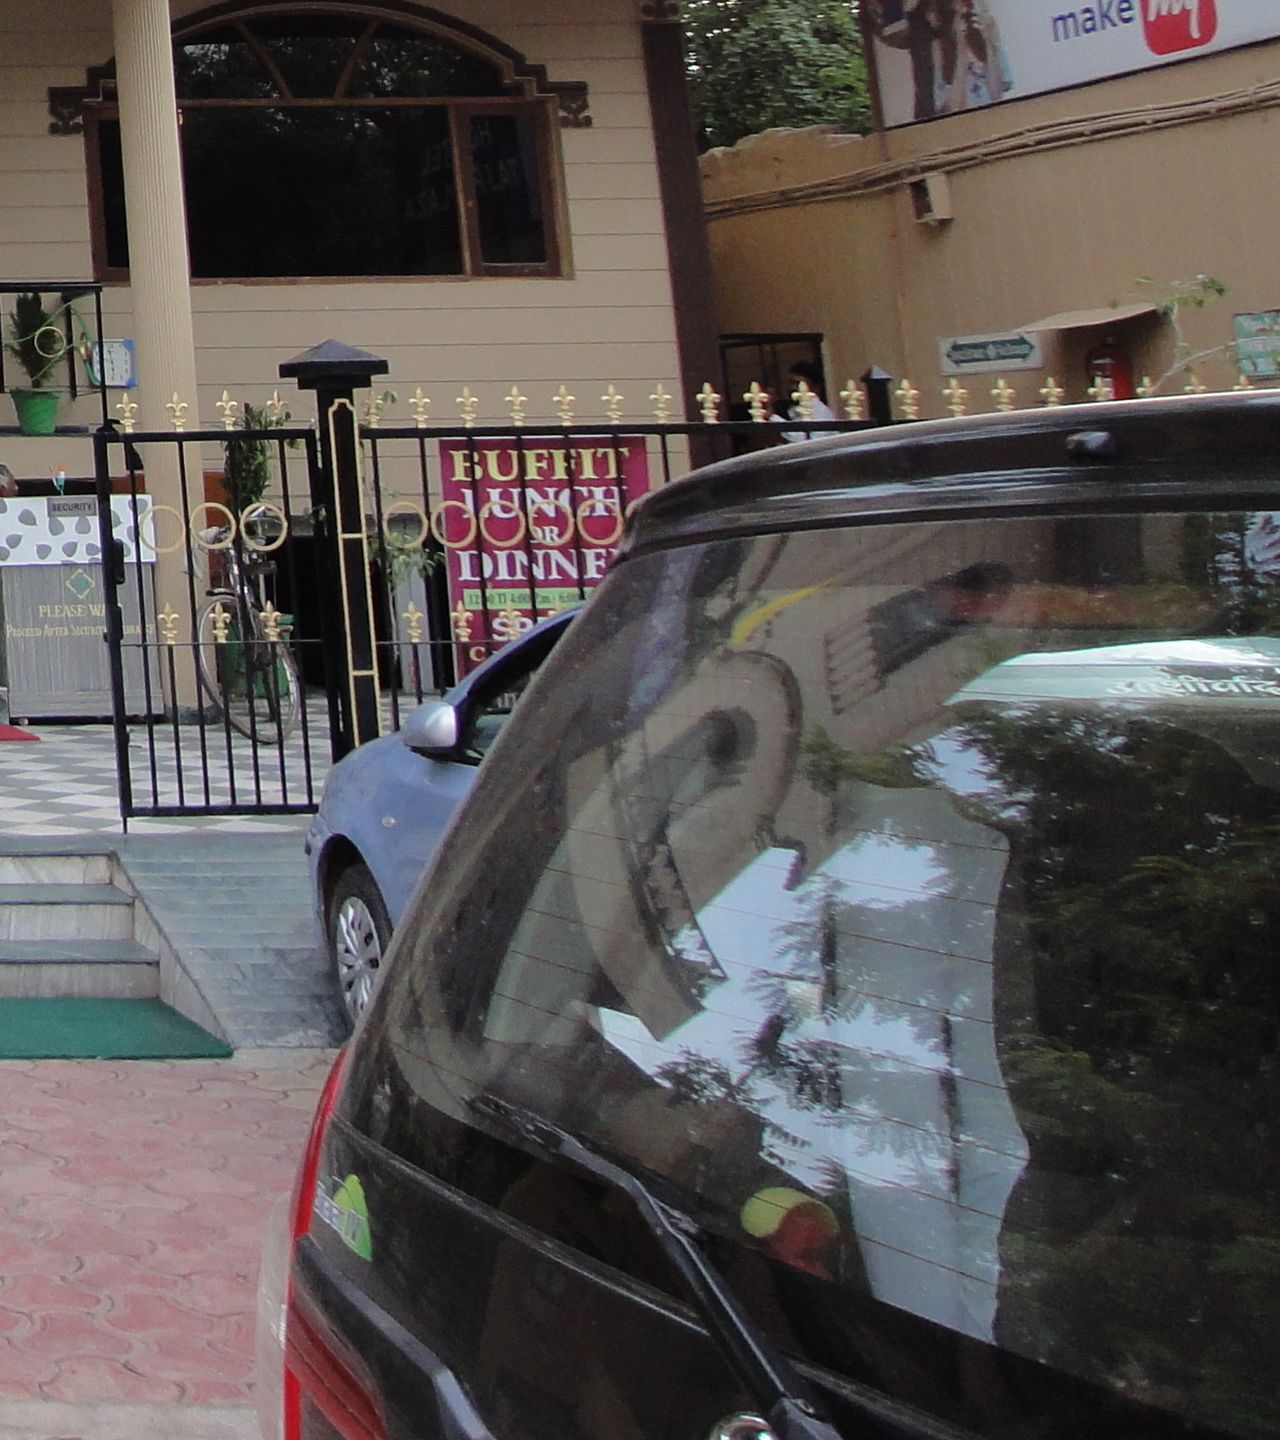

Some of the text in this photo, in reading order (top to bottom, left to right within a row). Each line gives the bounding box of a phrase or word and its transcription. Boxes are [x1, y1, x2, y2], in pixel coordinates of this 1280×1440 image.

[51, 502, 92, 512] SECURITY
[455, 548, 620, 581] DINNE
[39, 604, 86, 618] PLEASE
